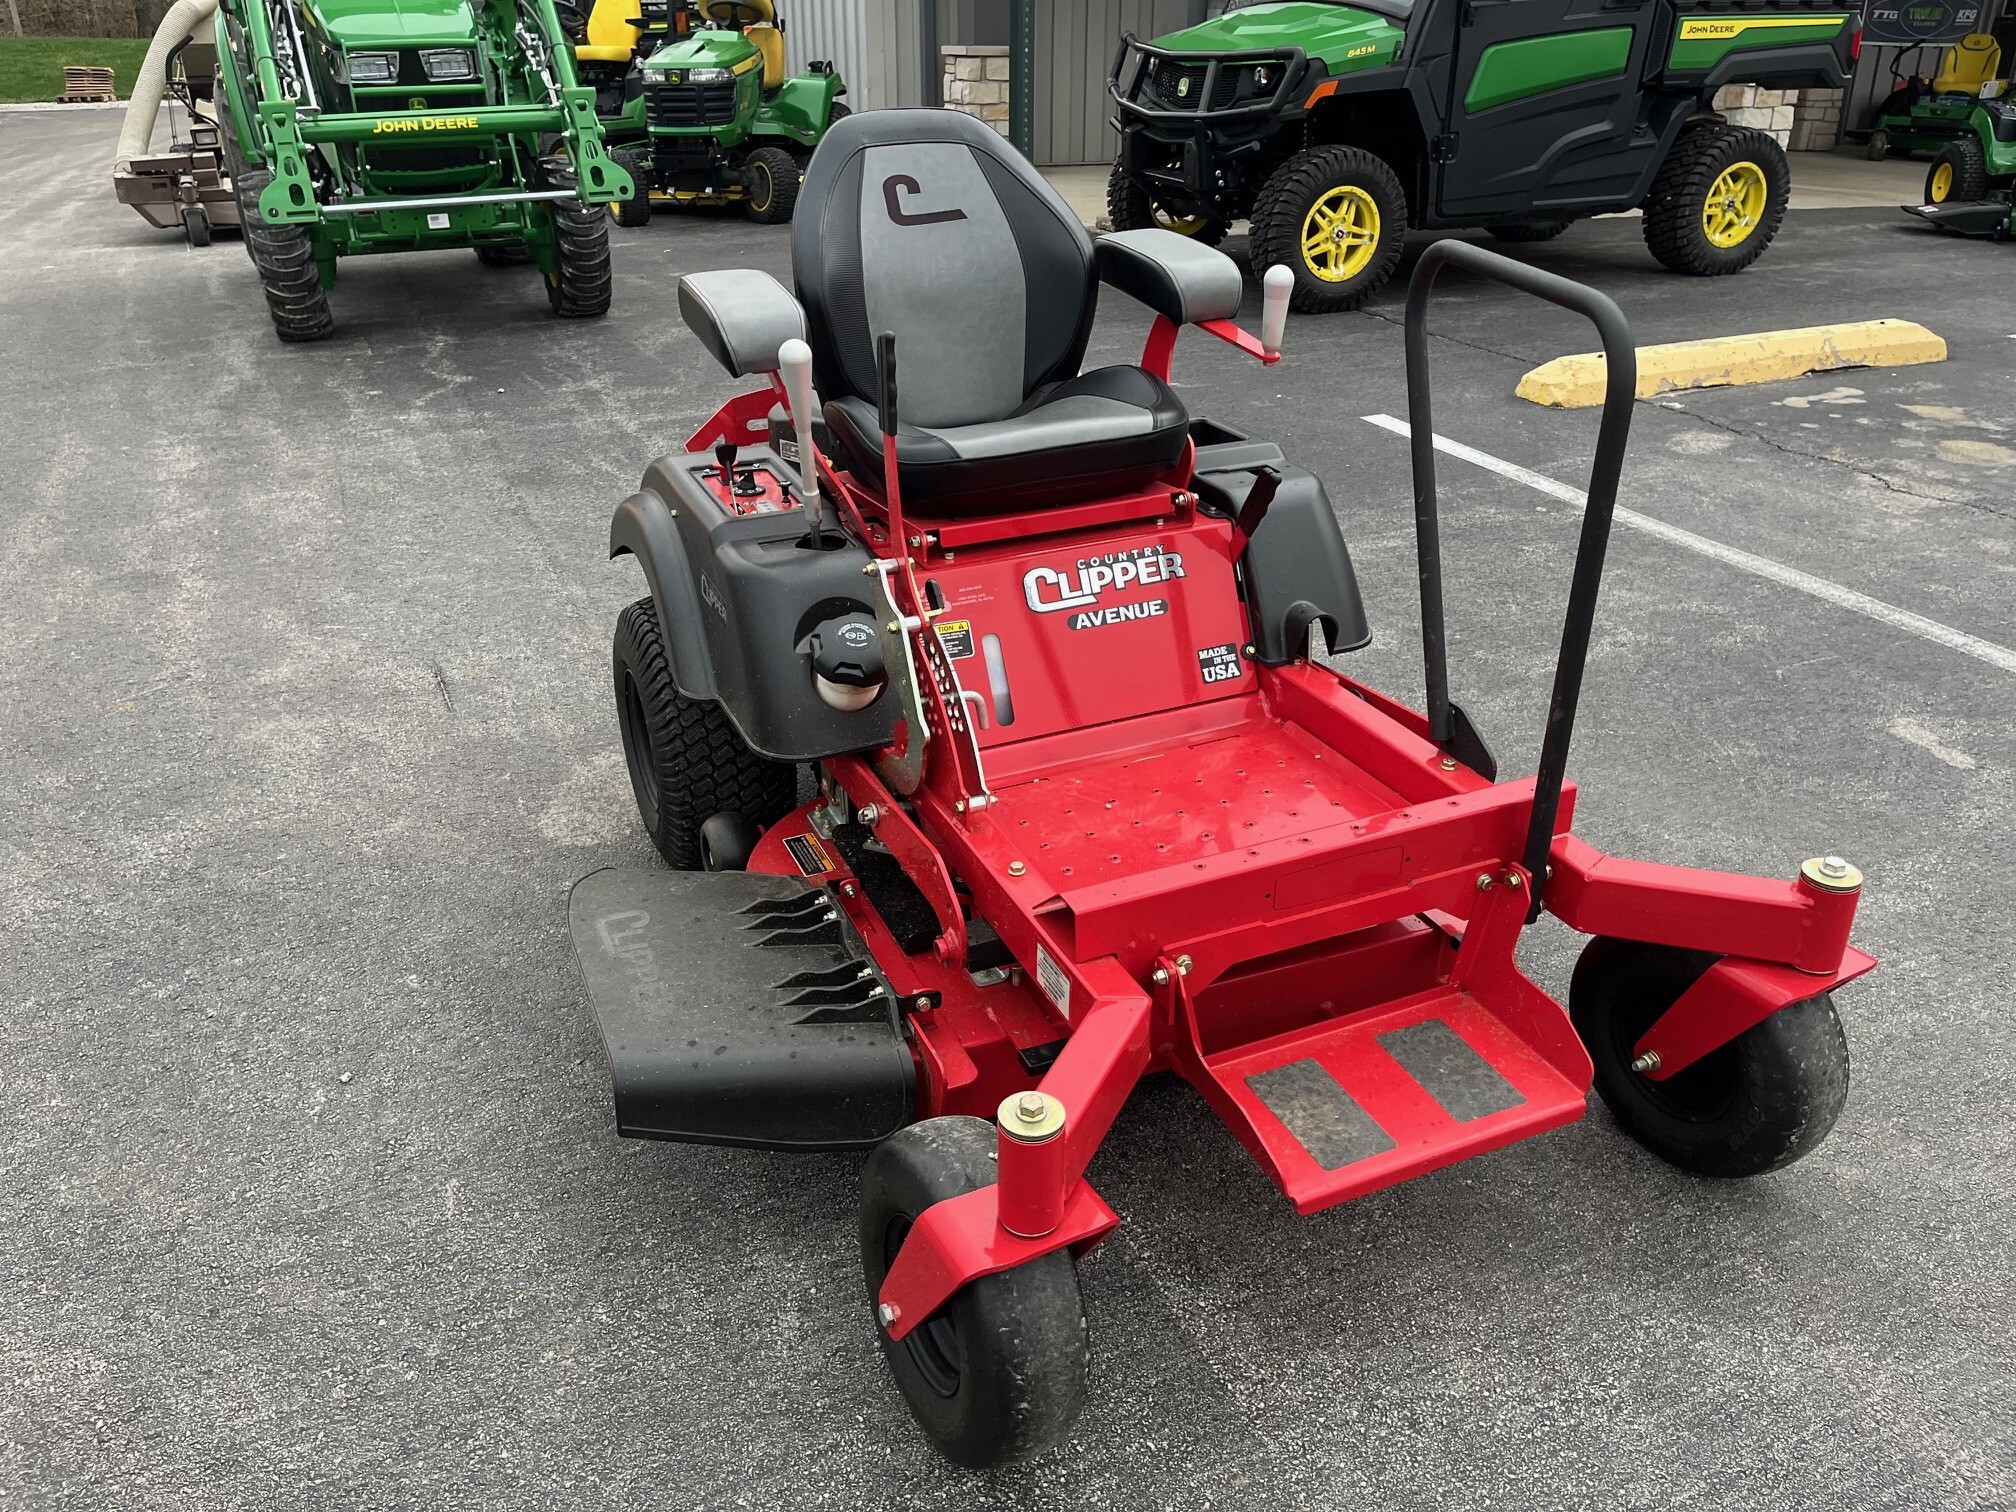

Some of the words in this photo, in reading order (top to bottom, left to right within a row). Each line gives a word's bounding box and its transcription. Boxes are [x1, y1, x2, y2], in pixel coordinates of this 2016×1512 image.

[1872, 9, 1899, 19] TTG
[1956, 9, 1978, 19] KFG
[1687, 26, 1708, 34] JOHN
[1709, 25, 1735, 33] DEERE
[373, 119, 419, 134] JOHN
[421, 117, 479, 131] DEERE
[1076, 544, 1165, 569] COUNTRY
[1023, 552, 1187, 613] CLIPPER
[1075, 599, 1165, 630] AVENUE
[938, 624, 955, 632] TION
[1198, 646, 1228, 660] MADE
[1213, 656, 1222, 665] IN
[1221, 653, 1237, 663] THE
[1202, 662, 1240, 683] USA
